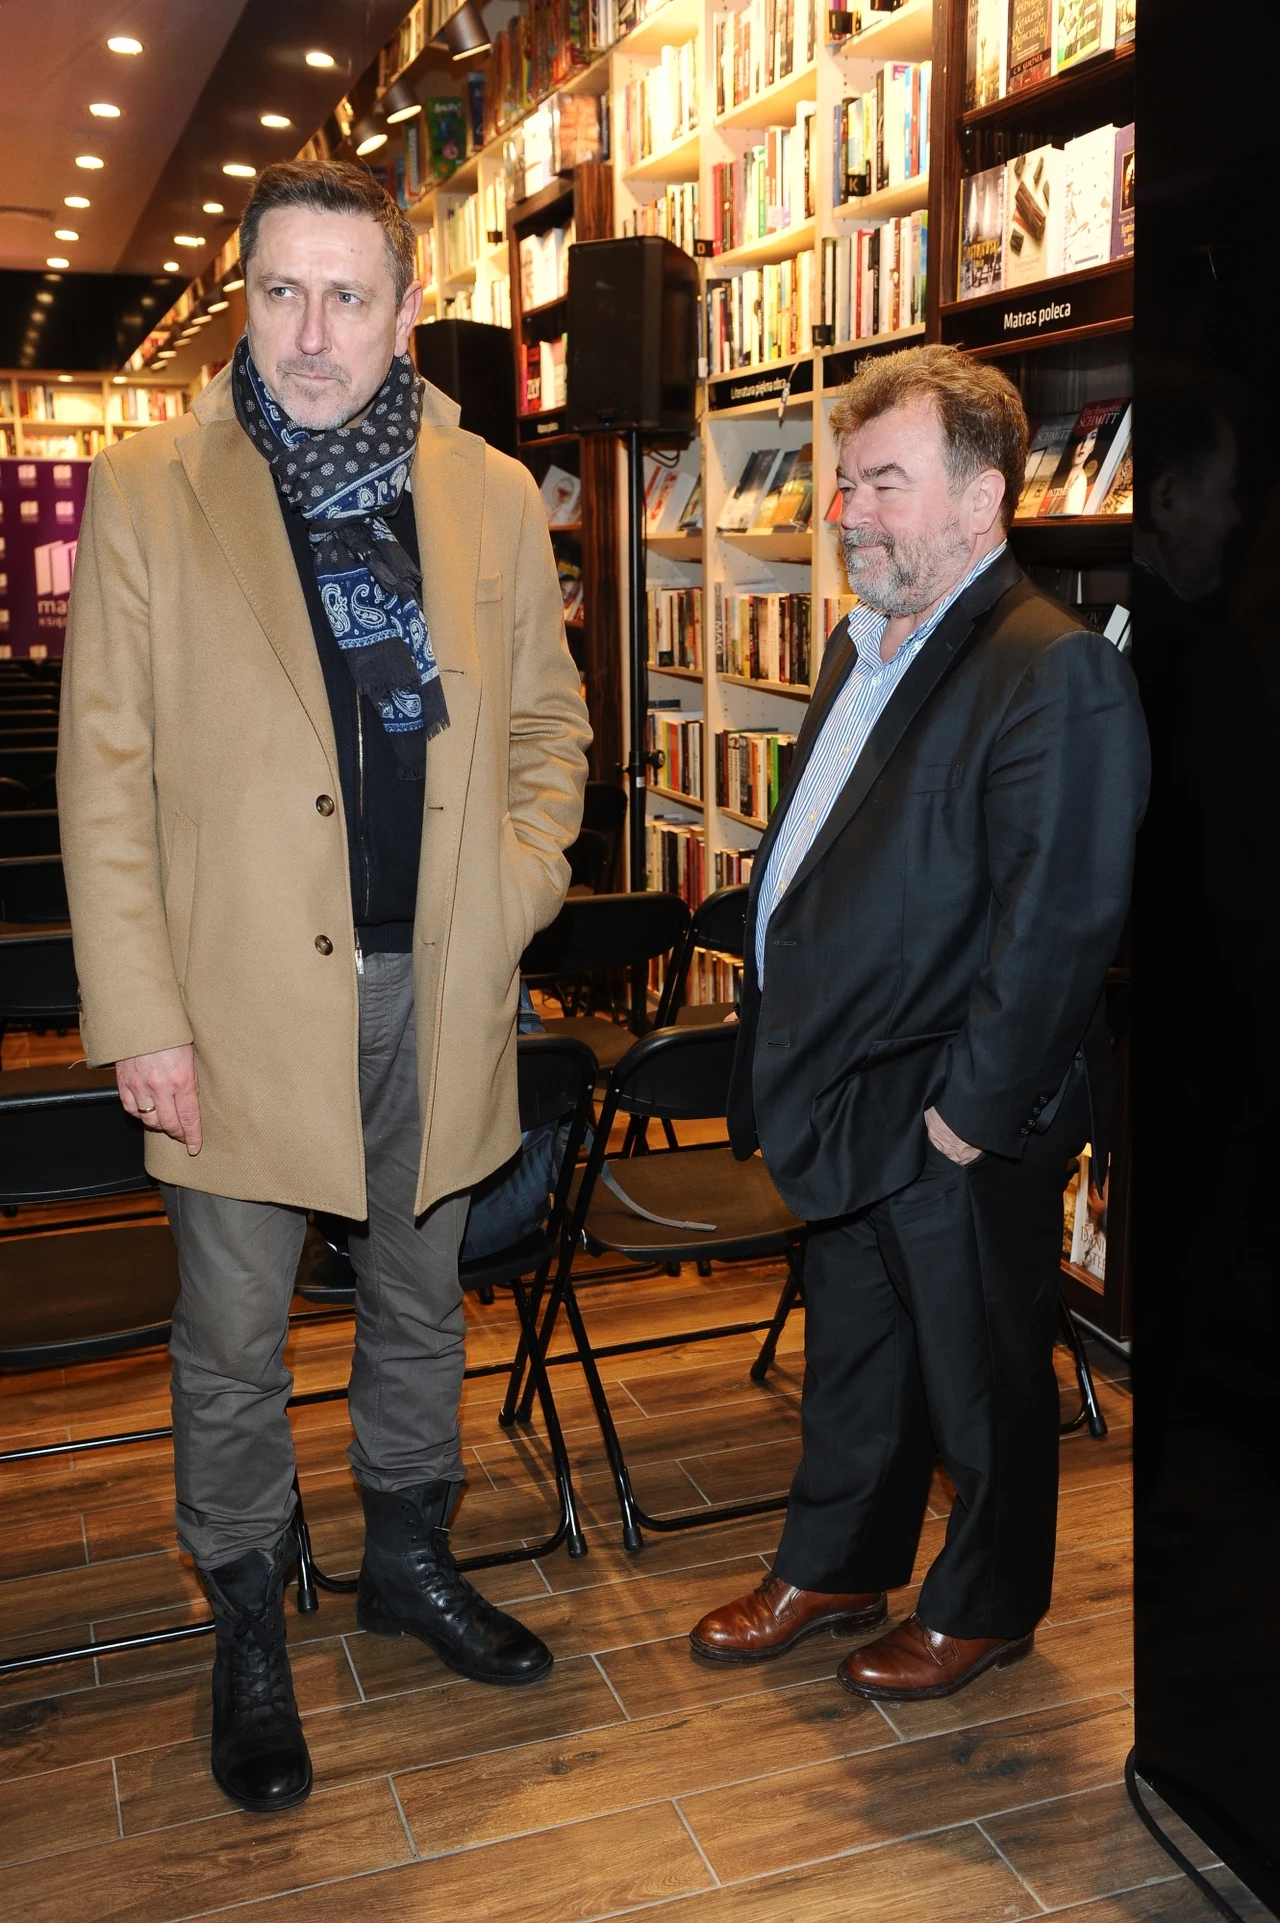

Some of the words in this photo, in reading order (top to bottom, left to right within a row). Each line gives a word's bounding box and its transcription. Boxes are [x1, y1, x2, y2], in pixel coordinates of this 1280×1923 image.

[849, 178, 858, 192] K
[1004, 310, 1037, 330] Matras
[1038, 302, 1071, 327] poleca
[1078, 412, 1120, 428] SCHMITT
